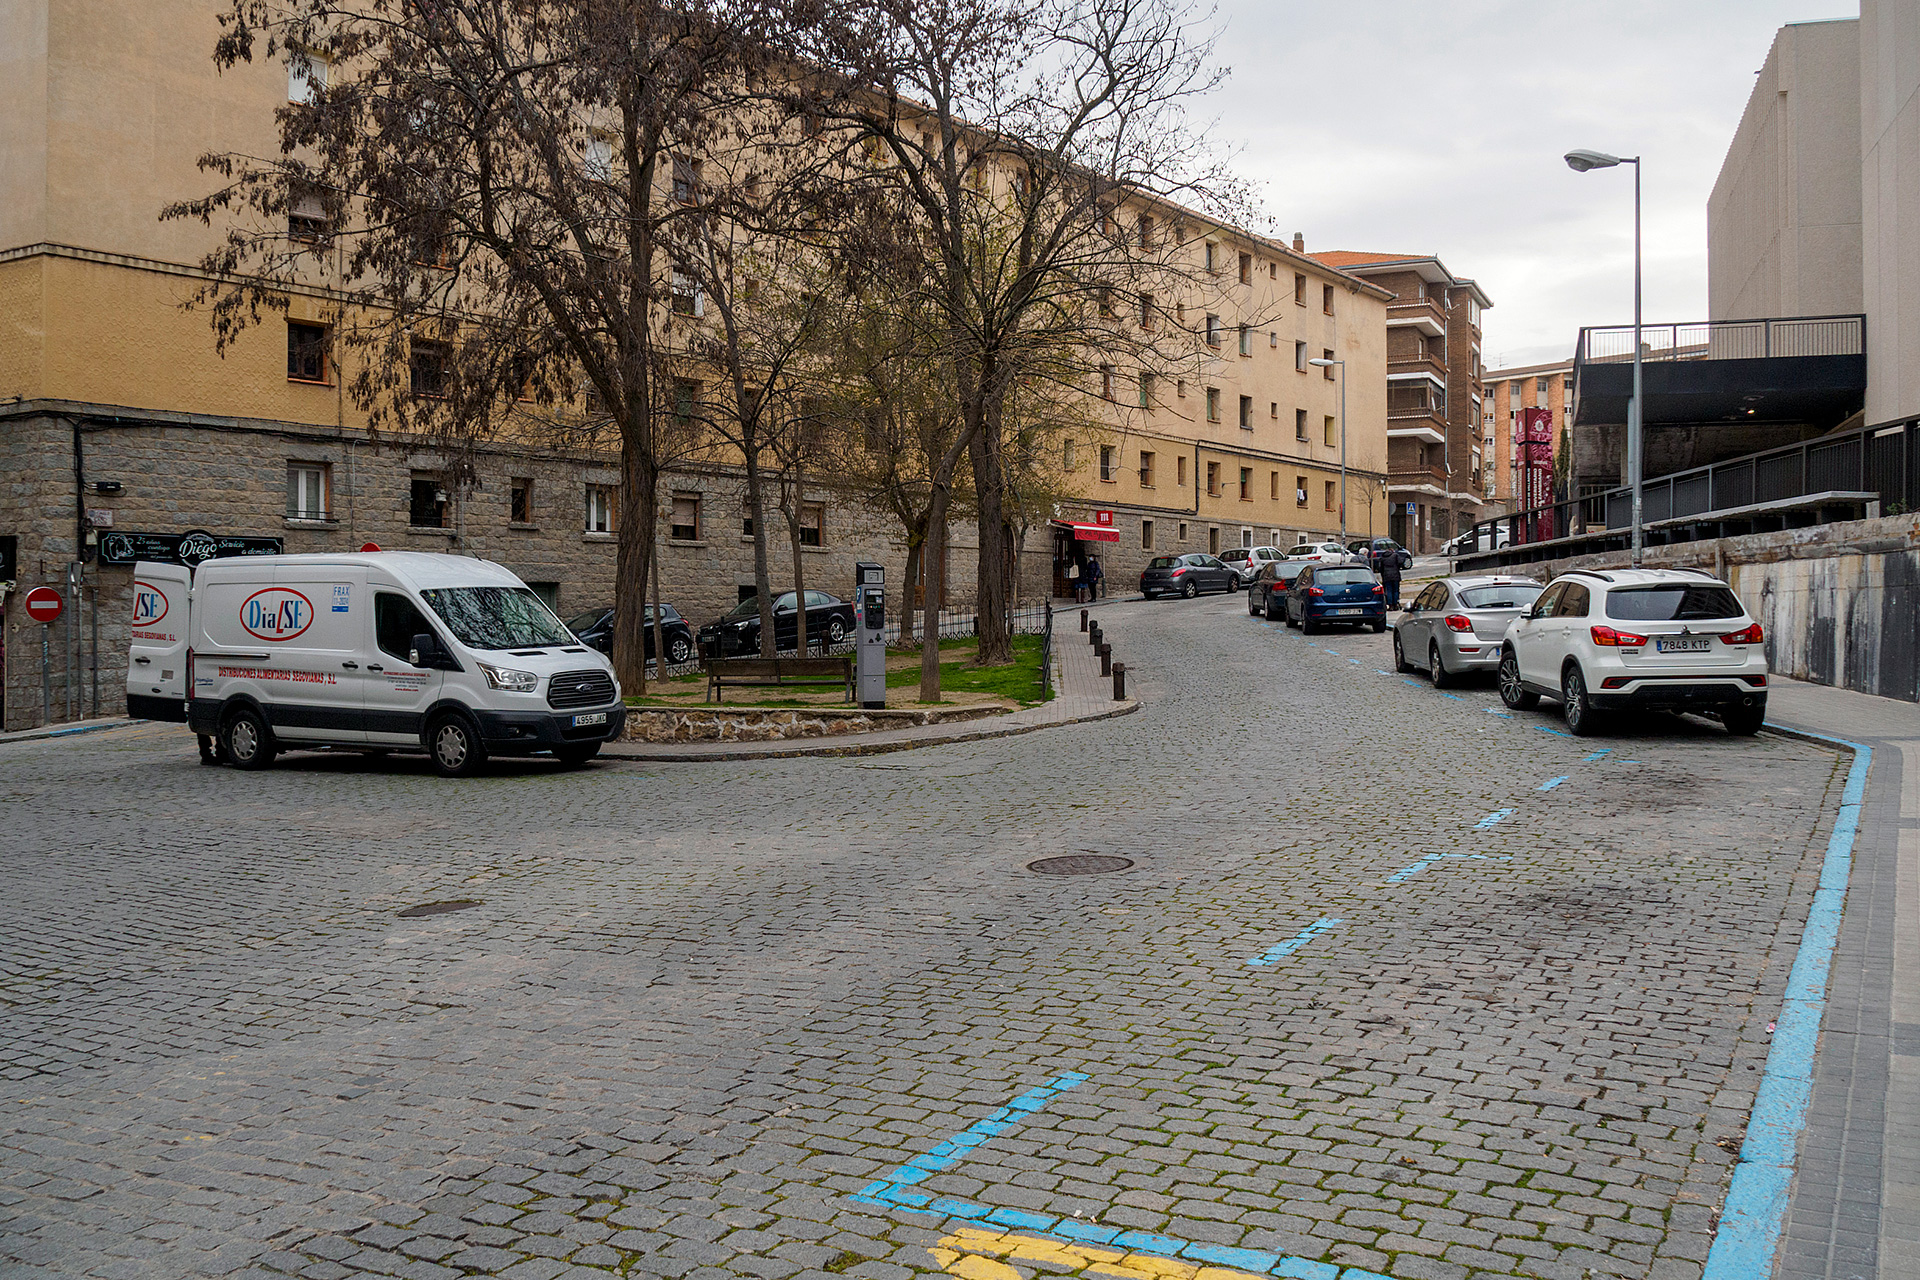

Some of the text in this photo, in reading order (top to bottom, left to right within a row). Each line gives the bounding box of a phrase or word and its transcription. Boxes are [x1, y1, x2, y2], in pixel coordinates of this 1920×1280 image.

[179, 540, 218, 559] Diego
[132, 593, 158, 620] LSE
[1662, 640, 1710, 650] 7848 KTP
